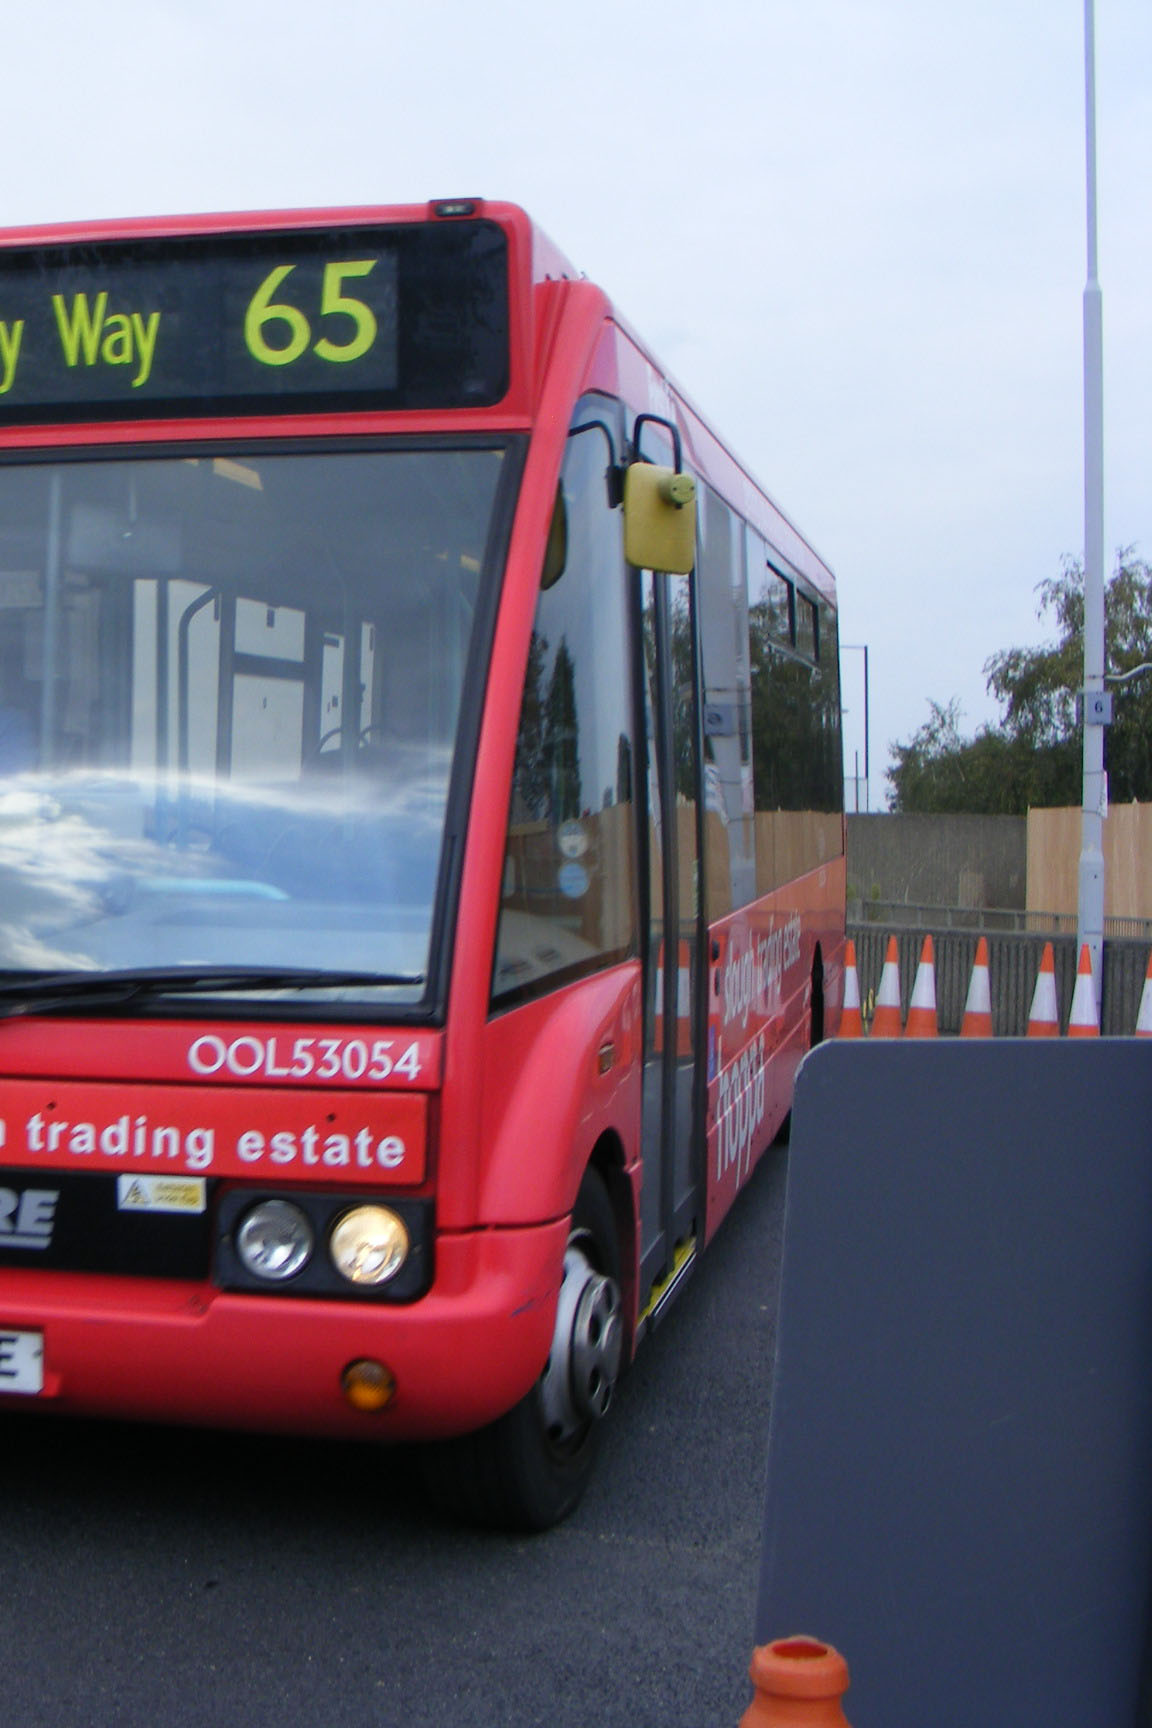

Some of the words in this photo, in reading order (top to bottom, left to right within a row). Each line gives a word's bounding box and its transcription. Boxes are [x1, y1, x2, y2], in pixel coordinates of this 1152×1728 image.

[52, 291, 160, 387] Way
[243, 259, 378, 366] 65
[27, 1113, 216, 1170] trading
[237, 1125, 407, 1168] estate
[716, 1033, 765, 1191] hoppa
